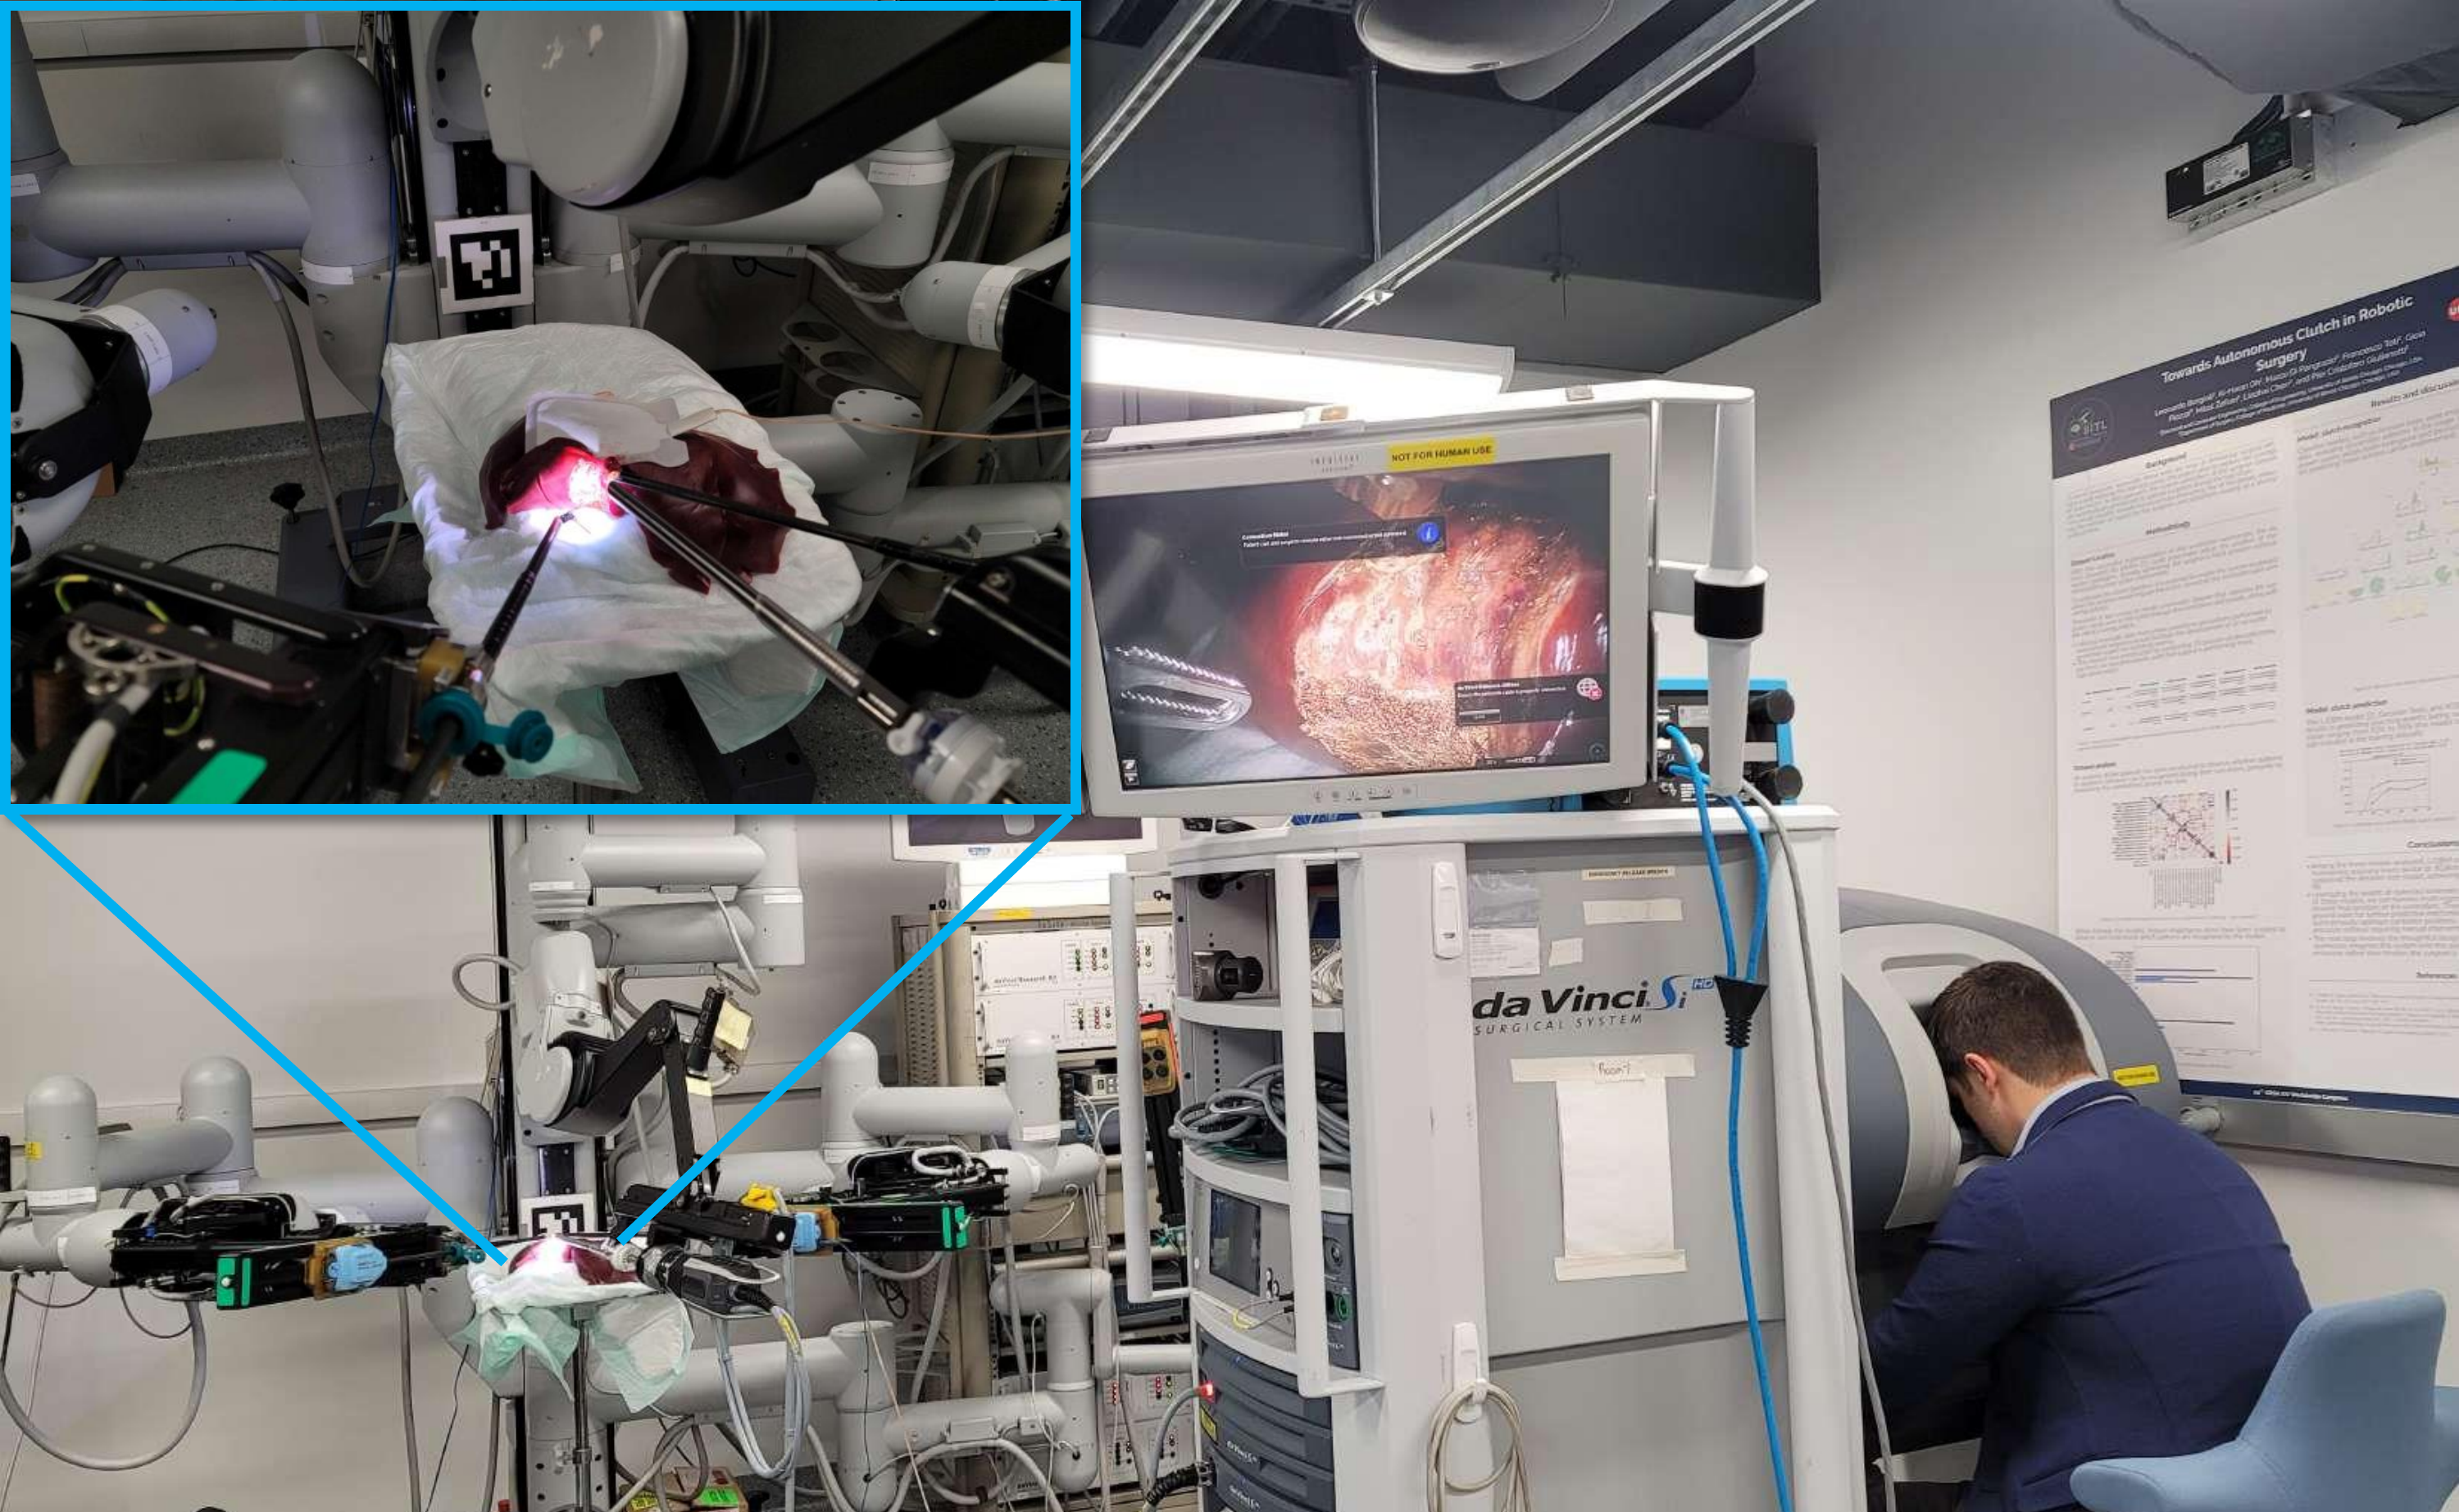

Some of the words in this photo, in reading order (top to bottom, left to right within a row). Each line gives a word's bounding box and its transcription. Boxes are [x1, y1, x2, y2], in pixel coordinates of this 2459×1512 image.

[2161, 359, 2211, 384] Towards
[2213, 333, 2294, 369] Autonomous
[2296, 316, 2341, 341] Clutch
[2343, 314, 2357, 327] in
[2358, 295, 2415, 322] Robotic
[2255, 347, 2308, 372] Surgery
[1392, 453, 1411, 462] NOT
[1413, 451, 1433, 461] FOR
[1435, 447, 1470, 459] HUMAN
[1472, 445, 1493, 455] USE
[1691, 978, 1716, 990] HD
[1472, 991, 1531, 1019] da
[1541, 980, 1648, 1015] Vinci
[1475, 1020, 1566, 1036] SURGICAL
[1575, 1013, 1643, 1030] SYSTEM
